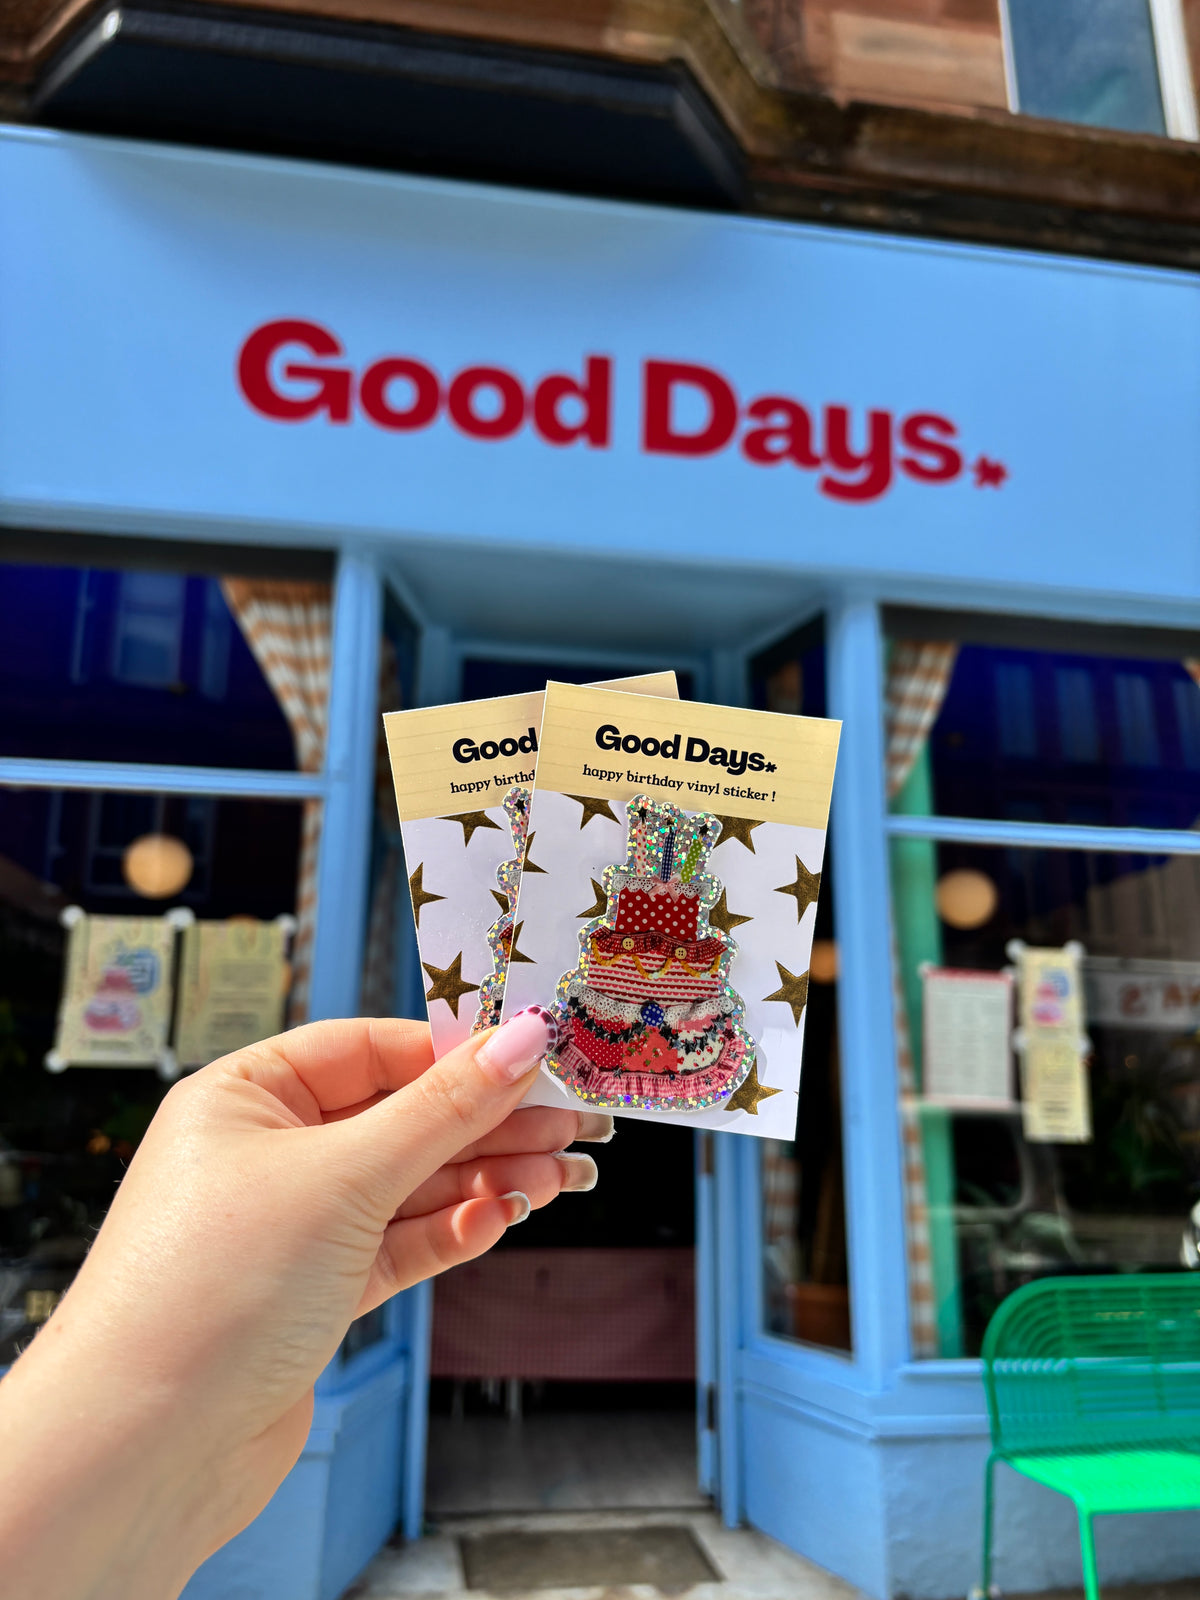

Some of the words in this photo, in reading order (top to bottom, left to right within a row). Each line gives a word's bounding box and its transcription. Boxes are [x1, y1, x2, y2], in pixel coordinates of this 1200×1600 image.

[237, 319, 612, 449] Good
[452, 726, 538, 763] Good
[596, 725, 681, 760] Good
[450, 779, 491, 793] happy
[494, 769, 536, 787] birthd
[582, 764, 623, 782] happy
[626, 770, 684, 790] birthday
[687, 781, 720, 795] vinyl
[723, 786, 769, 801] sticker
